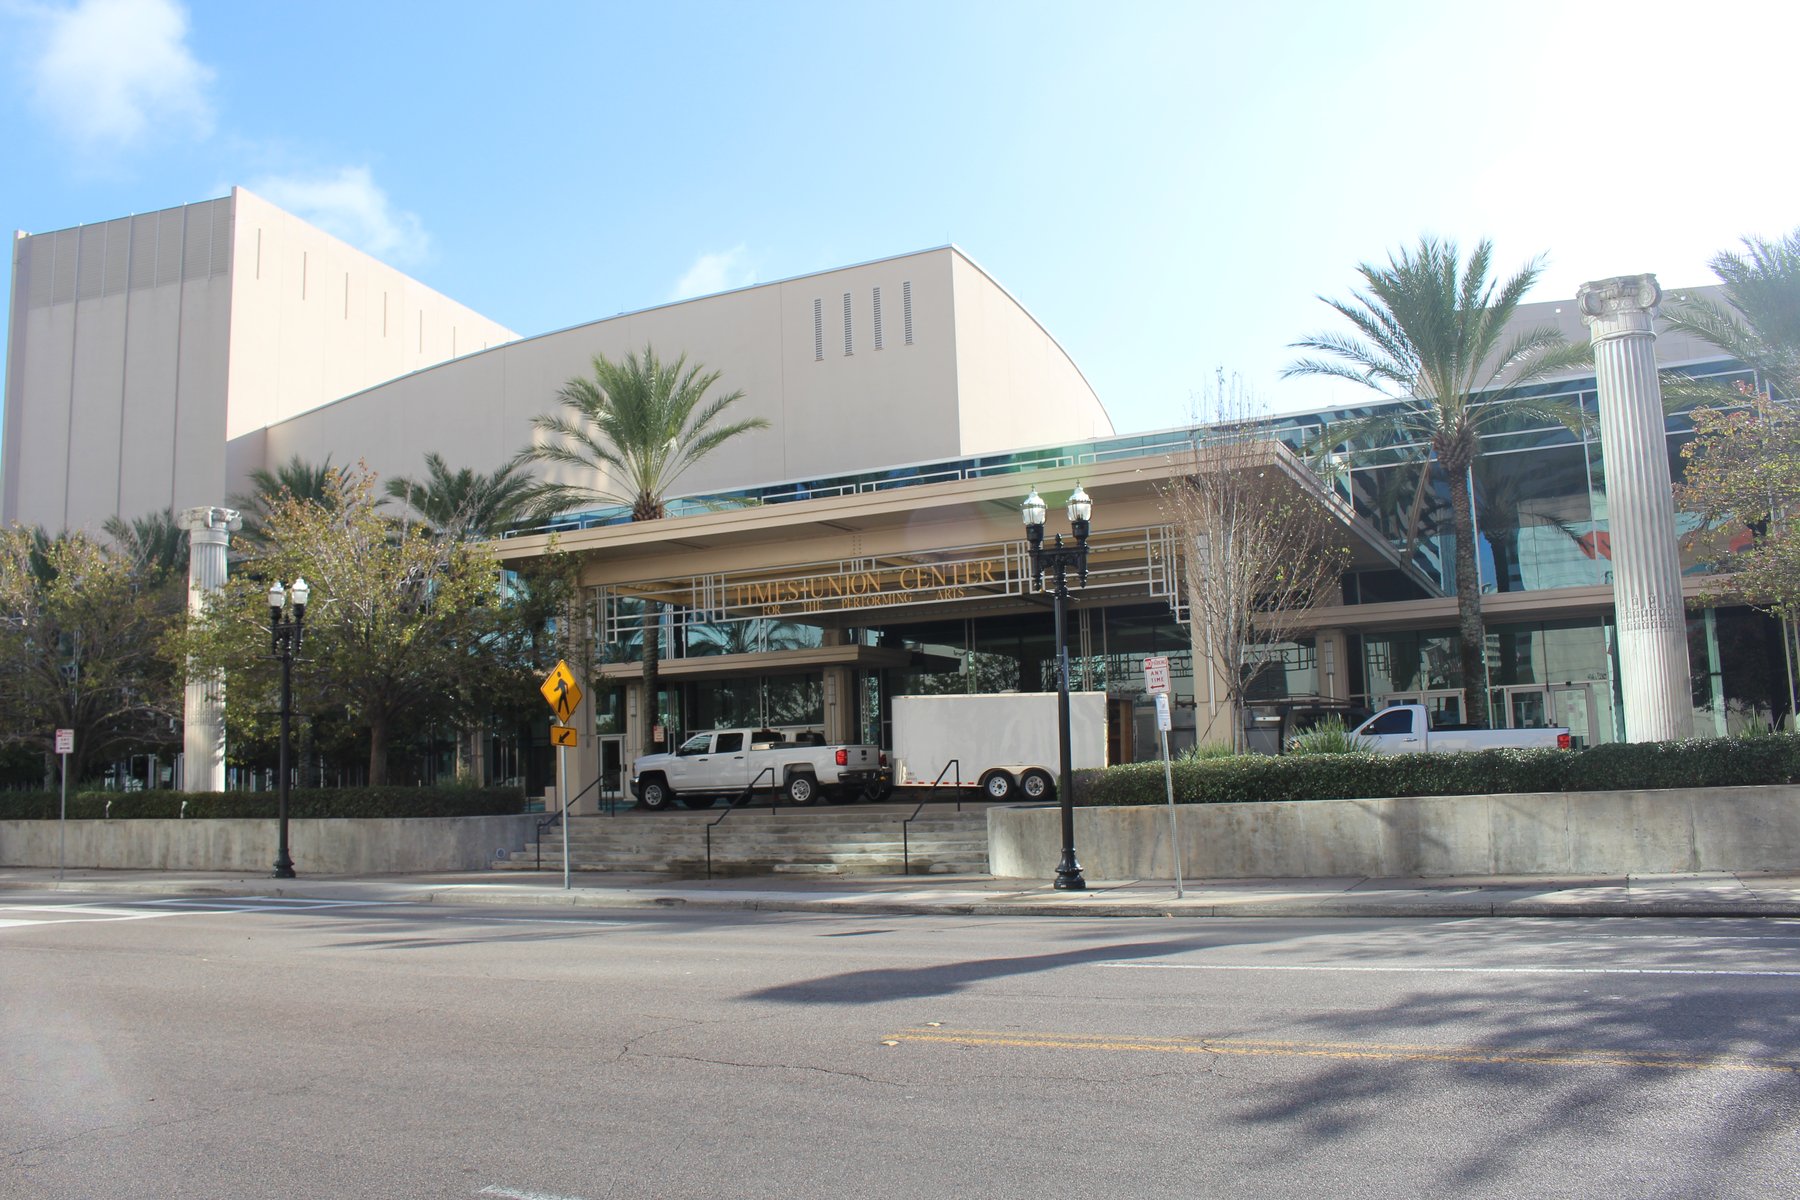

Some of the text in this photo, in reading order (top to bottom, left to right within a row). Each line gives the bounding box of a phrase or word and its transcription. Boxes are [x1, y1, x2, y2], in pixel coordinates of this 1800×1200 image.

[900, 559, 995, 591] CENTER
[762, 586, 965, 617] FOR THE PERFORMING ARTS
